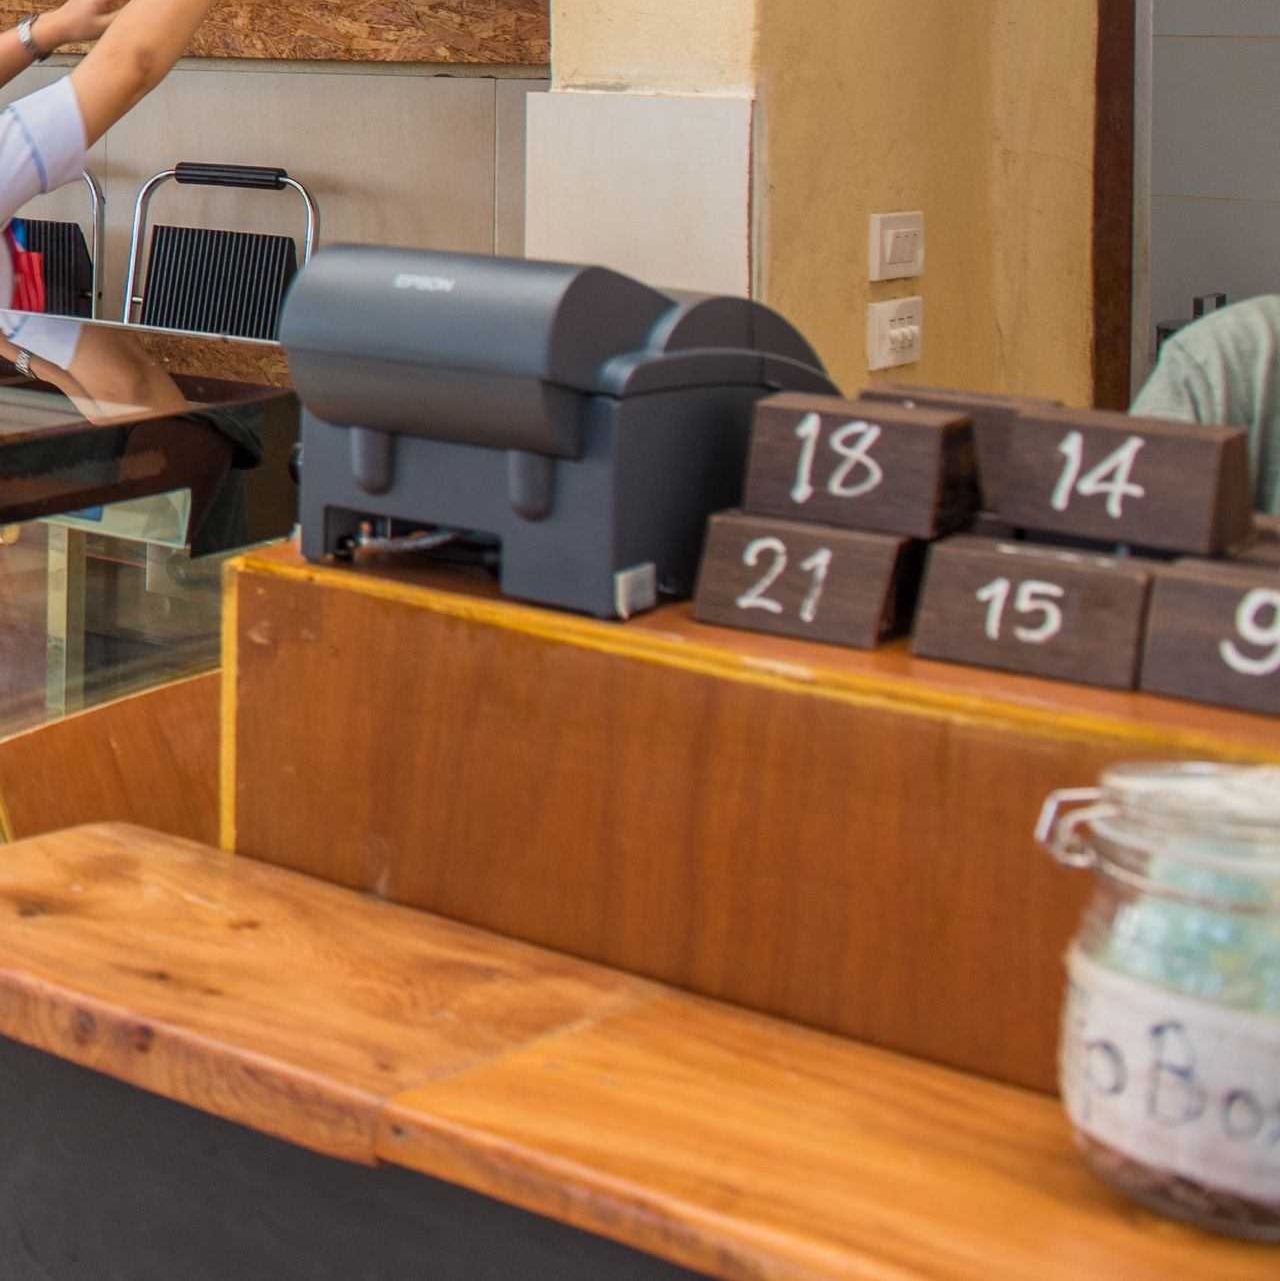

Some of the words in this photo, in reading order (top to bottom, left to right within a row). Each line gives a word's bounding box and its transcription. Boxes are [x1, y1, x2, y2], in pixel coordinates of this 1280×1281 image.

[791, 412, 884, 504] 18
[1052, 430, 1145, 517] 14
[734, 536, 833, 623] 21
[975, 575, 1065, 643] 15
